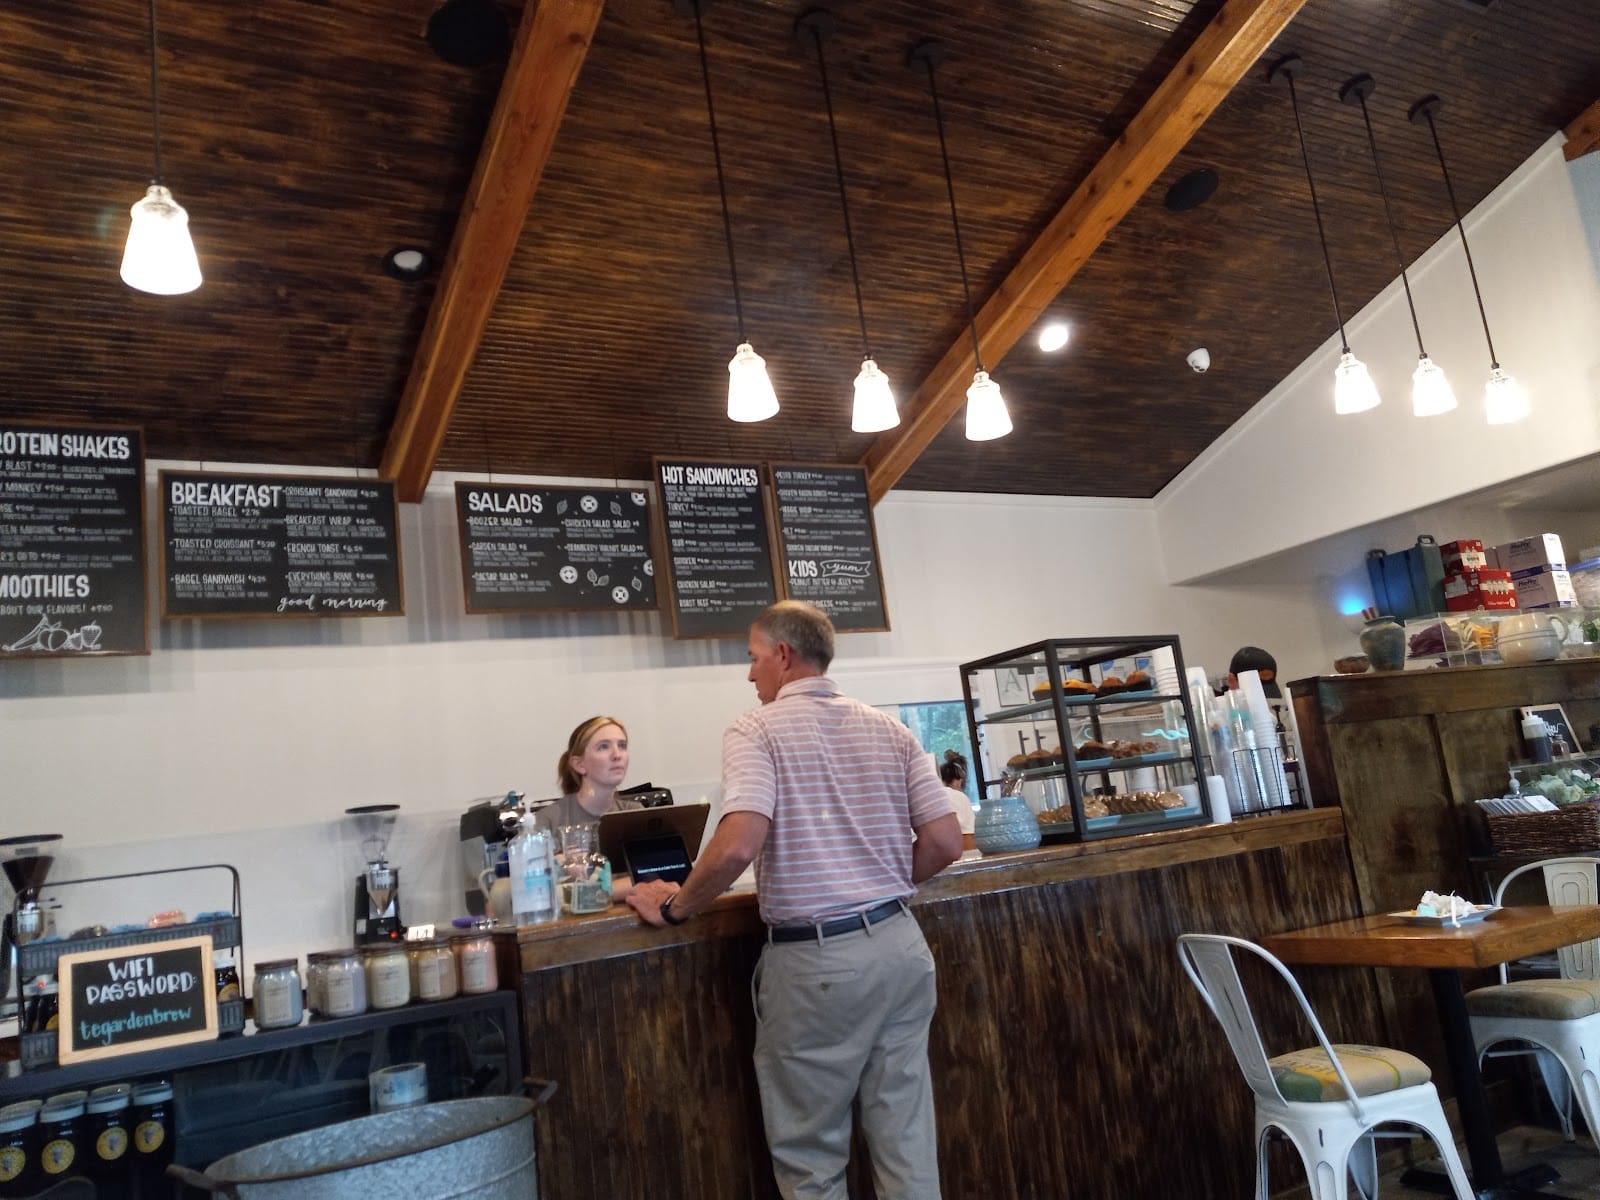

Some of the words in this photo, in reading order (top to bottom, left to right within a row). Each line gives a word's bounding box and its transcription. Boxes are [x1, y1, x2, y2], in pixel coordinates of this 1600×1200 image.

[0, 432, 58, 456] OTEIN
[61, 435, 130, 459] SHAKES
[661, 466, 684, 484] HOT
[686, 467, 758, 486] SANDWICHES
[172, 482, 282, 508] BREAKFAST
[285, 486, 322, 497] CROISSANT
[324, 488, 358, 498] SANDWICH
[468, 491, 544, 514] SALADS
[172, 506, 209, 516] TOASTED
[211, 506, 237, 517] BAGEL
[285, 515, 326, 525] BREAKFAST
[500, 517, 522, 527] SALAD
[612, 519, 631, 528] SALAD
[173, 538, 212, 549] TOASTED
[213, 539, 255, 549] CROISSANT
[287, 543, 316, 553] FRENCH
[318, 543, 340, 553] TOAST
[788, 560, 818, 577] KIDS
[826, 563, 863, 573] yum
[174, 574, 201, 584] BAGEL
[202, 574, 245, 585] SANDWICH
[288, 571, 331, 581] EVERYTHING
[0, 574, 90, 598] MOOTHIES
[0, 605, 24, 615] BOUT
[26, 604, 44, 614] OUR
[46, 604, 86, 614] FLAVORS!
[277, 594, 316, 612] good
[322, 597, 388, 611] morning
[1004, 669, 1023, 693] A
[107, 957, 154, 981] WIFI
[86, 971, 197, 1006] PASSWORD:
[79, 1006, 192, 1046] tegardenbrew
